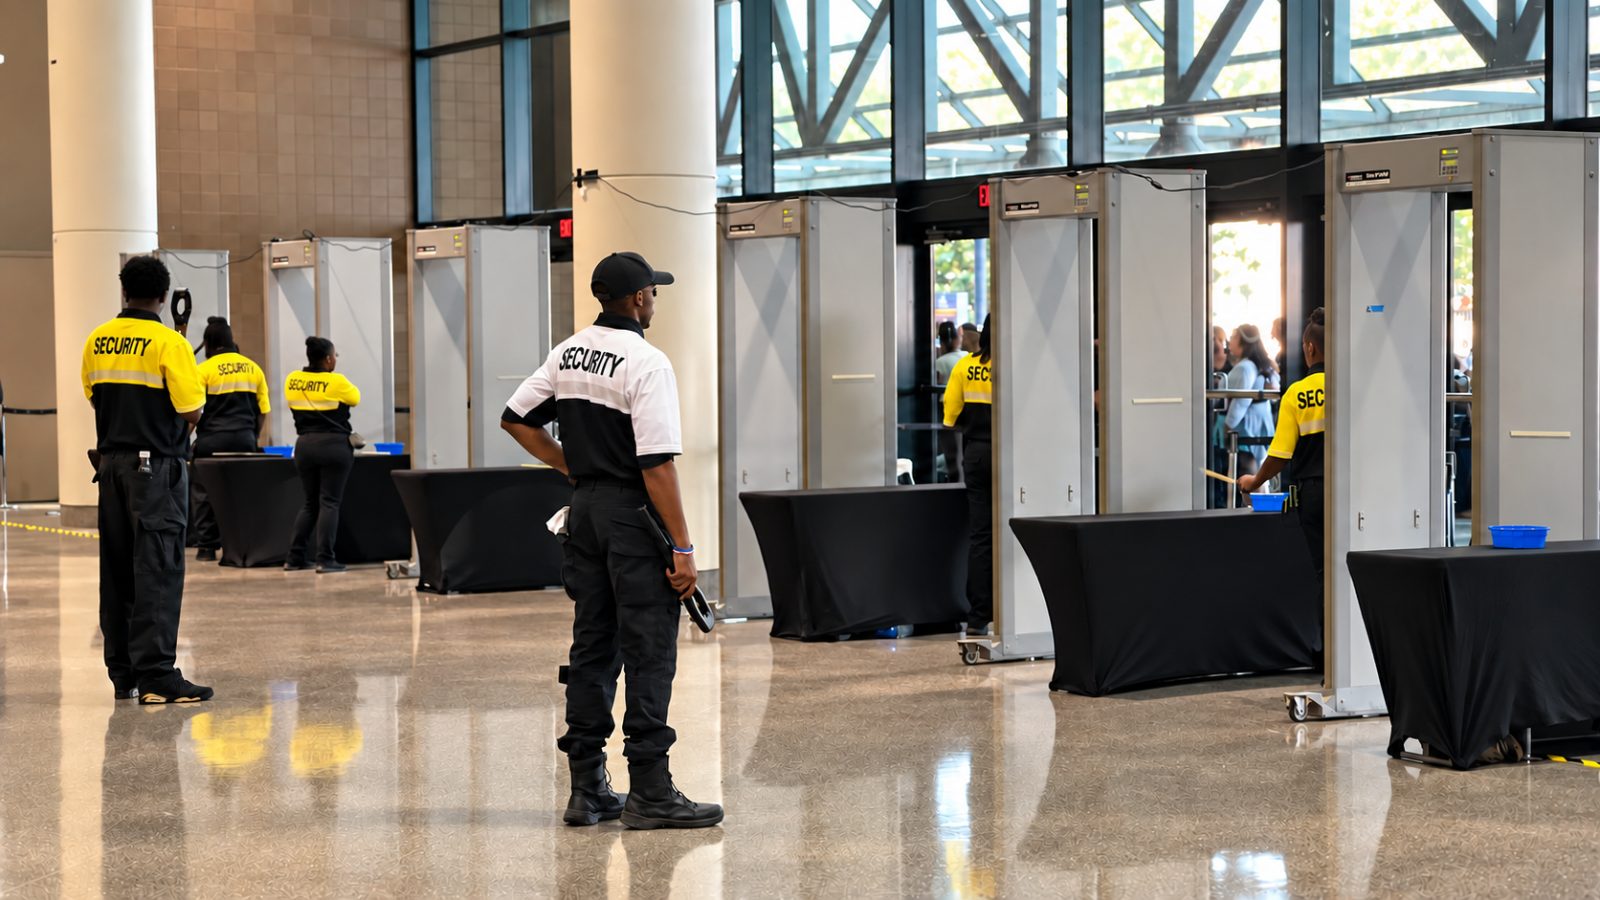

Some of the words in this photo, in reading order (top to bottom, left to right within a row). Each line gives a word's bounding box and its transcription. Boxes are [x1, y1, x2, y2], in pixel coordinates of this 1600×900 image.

[93, 336, 152, 356] SECURITY
[218, 361, 254, 376] SECURITY
[558, 346, 625, 378] SECURITY
[967, 365, 993, 382] SEC
[288, 378, 329, 393] SECURITY
